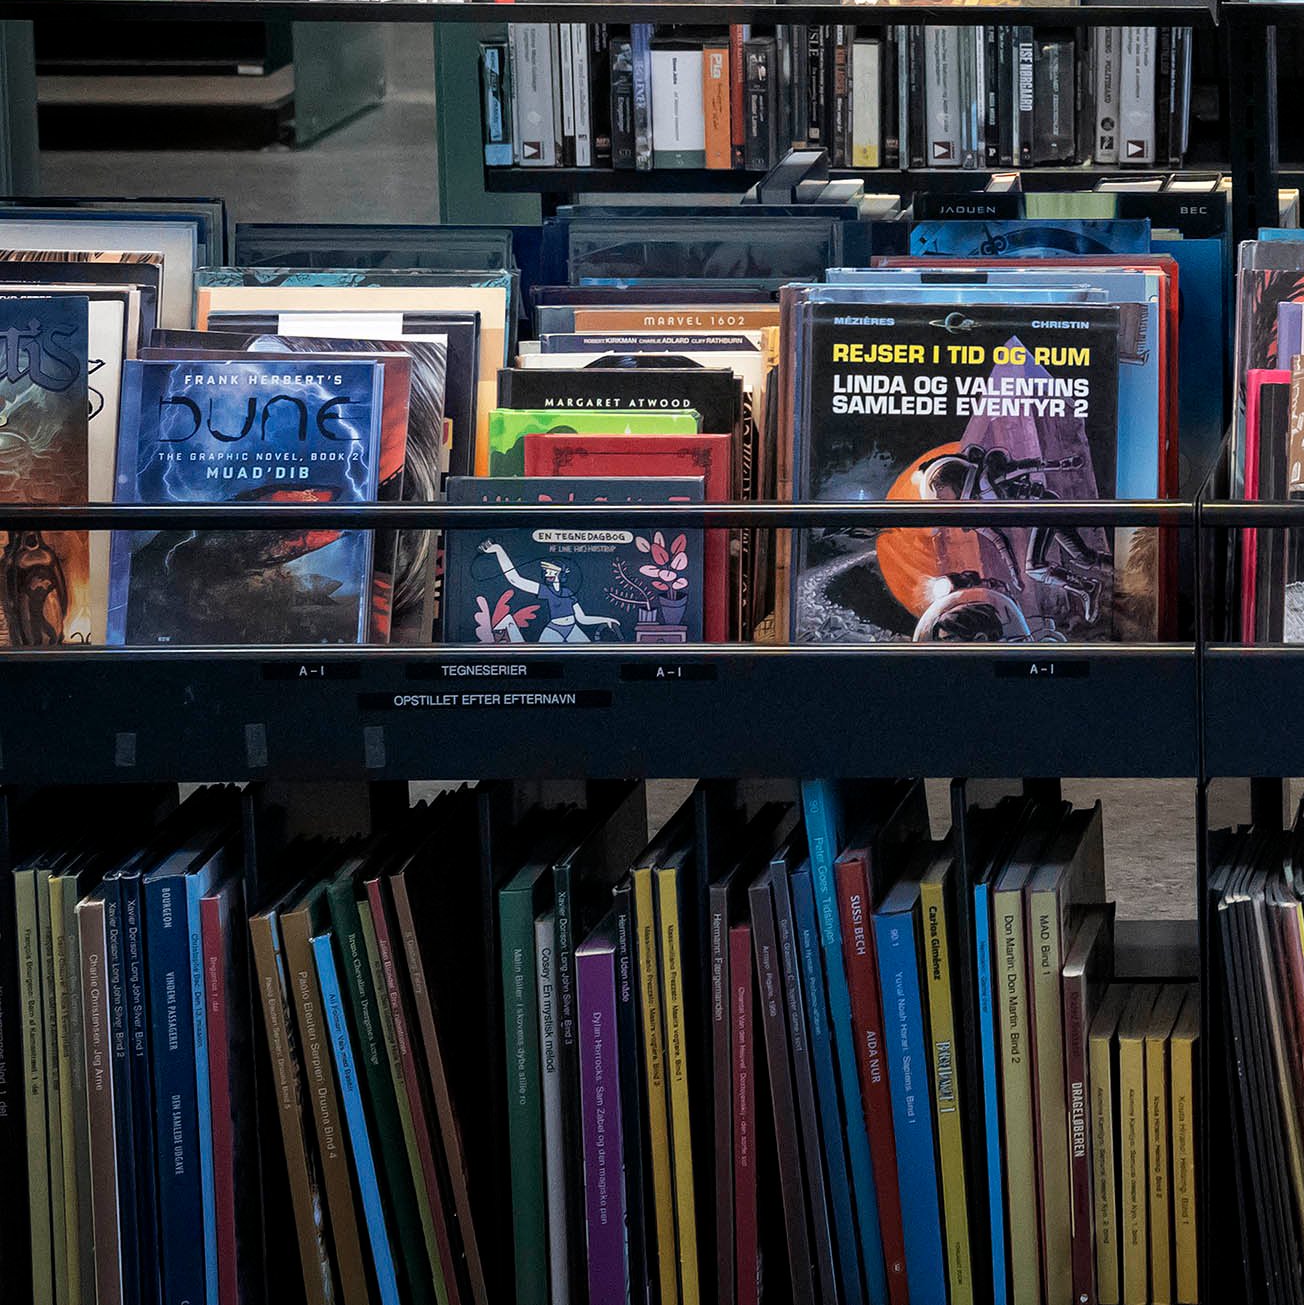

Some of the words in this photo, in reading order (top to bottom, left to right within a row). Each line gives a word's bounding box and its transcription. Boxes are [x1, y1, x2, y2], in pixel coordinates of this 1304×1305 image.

[643, 315, 702, 327] MARVEL
[708, 315, 746, 327] 1602
[832, 343, 925, 365] REJSER
[932, 344, 940, 364] I
[945, 345, 985, 365] TID
[992, 347, 1027, 366] OG
[1034, 347, 1091, 367] RUM
[184, 374, 240, 386] FRANK
[247, 374, 343, 387] HERBERT'S
[832, 374, 907, 395] LINDA
[913, 376, 948, 395] OG
[955, 377, 1090, 398] VALENTINS
[544, 398, 622, 409] MARGARET
[629, 398, 691, 409] ATWOOD
[831, 396, 948, 416] SAMLEDE
[955, 397, 1066, 417] EVENTYR
[1072, 399, 1089, 418] 2
[157, 394, 363, 444] DUNE
[157, 452, 184, 462] THE
[188, 452, 249, 463] GRAPHIC
[255, 452, 305, 464] NOVEL,
[310, 452, 348, 463] BOOK
[206, 464, 311, 482] MUAD'DIB
[538, 531, 552, 542] EN
[555, 531, 626, 542] TEGNEDAGBOG
[441, 665, 528, 676] TEGNESERIER
[393, 694, 459, 706] OPSTILLET
[461, 694, 501, 706] EFTER
[503, 693, 576, 705] EFTERNAVN
[161, 886, 173, 929] BOURGEON
[850, 895, 862, 927] SUSSI
[854, 927, 866, 956] BECH
[165, 970, 176, 1006] VINDENS
[167, 1006, 179, 1051] PASSAGERER
[866, 1030, 878, 1058] AIDA
[870, 1060, 881, 1084] NUR
